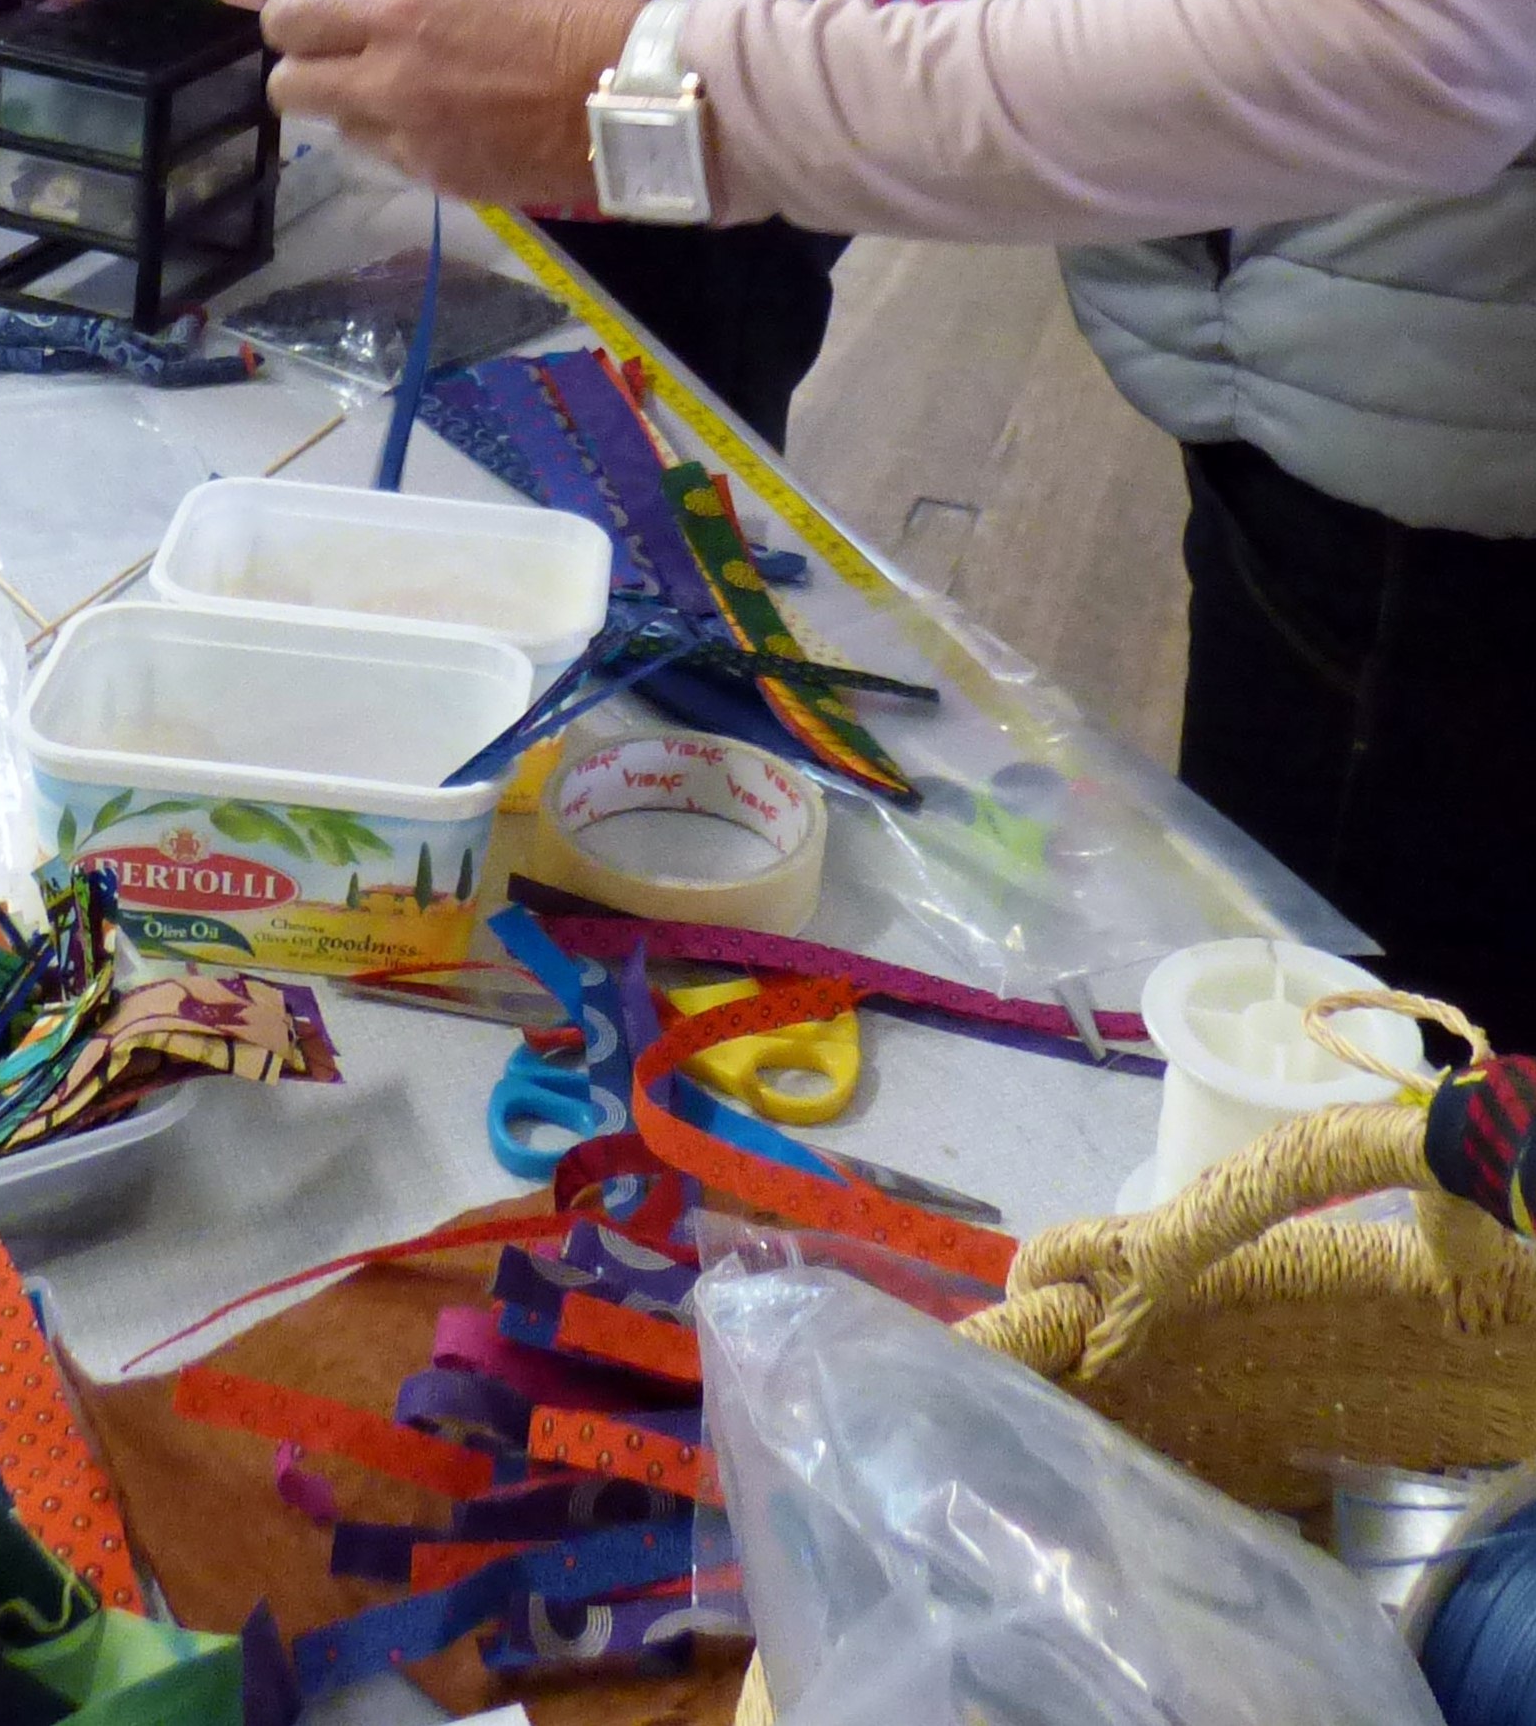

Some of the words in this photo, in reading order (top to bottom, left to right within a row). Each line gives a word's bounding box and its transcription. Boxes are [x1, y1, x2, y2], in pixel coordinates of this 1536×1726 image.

[623, 768, 683, 794] VIBAC
[94, 857, 277, 900] BERTOLLI
[143, 920, 187, 939] Olive
[191, 920, 220, 940] Oil
